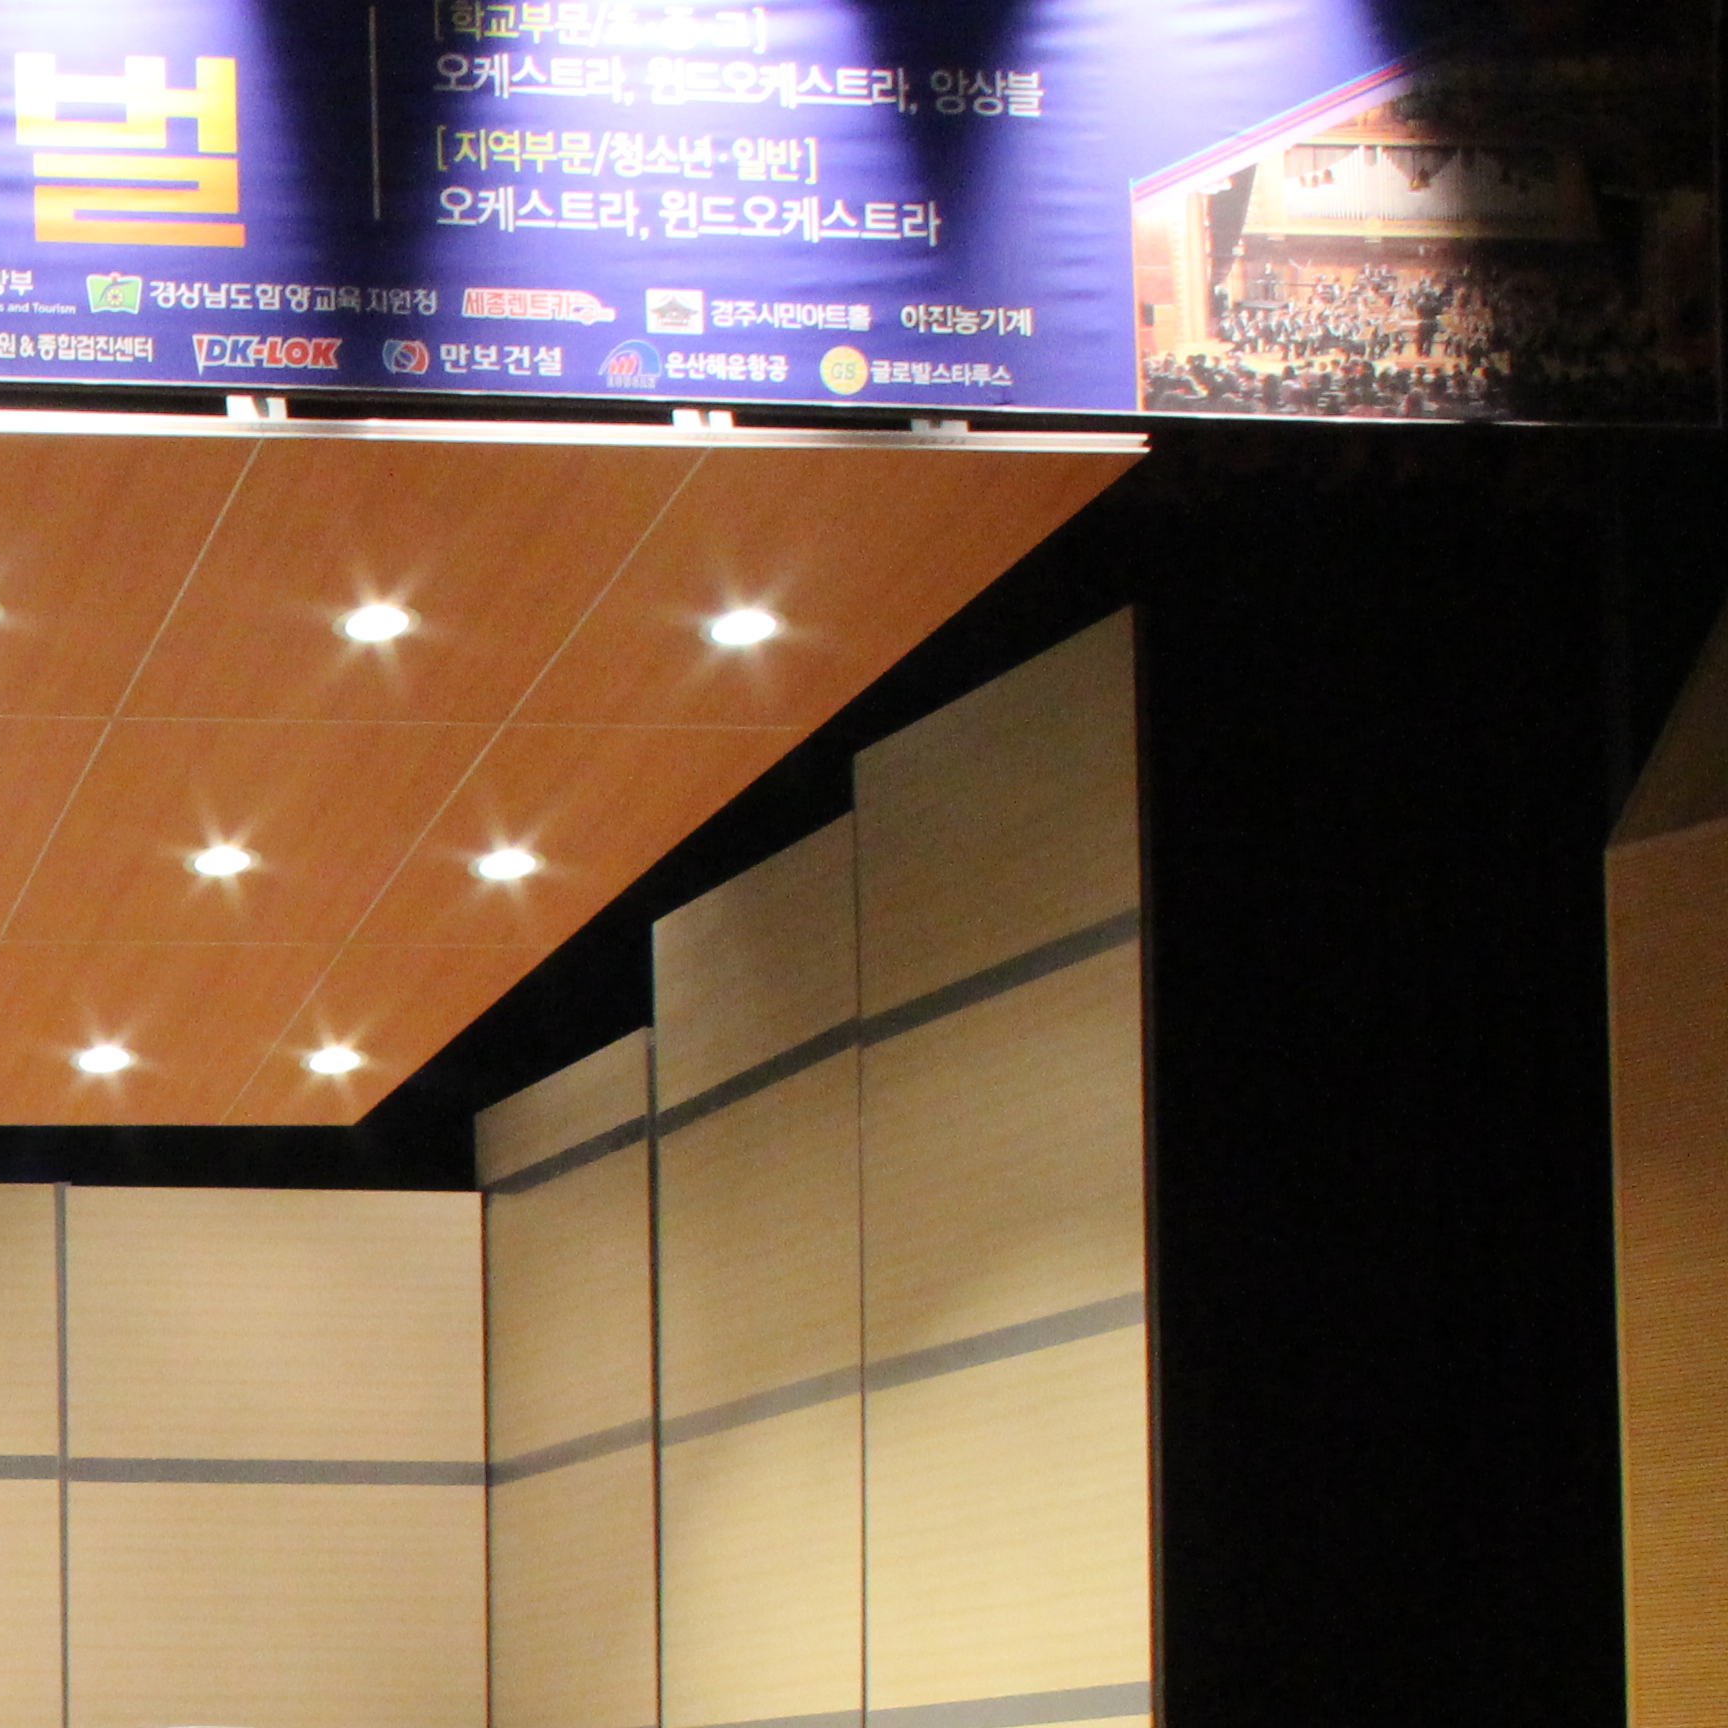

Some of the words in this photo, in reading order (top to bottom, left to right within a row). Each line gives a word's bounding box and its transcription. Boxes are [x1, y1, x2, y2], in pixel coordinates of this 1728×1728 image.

[433, 53, 634, 106] 오케스트라,
[930, 69, 1044, 117] 앙상블
[437, 186, 649, 241] 오케스트라,
[658, 191, 943, 246] 윈드오케스트라
[6, 301, 29, 313] and
[32, 301, 77, 315] Tourism
[710, 299, 871, 331] 경주시민아트홀
[900, 304, 1034, 336] 아진농기계
[20, 336, 35, 358] &
[37, 333, 155, 362] 종합검진센터
[192, 333, 342, 373] DK-LOK
[439, 343, 563, 376] 만보건설
[664, 350, 790, 382] 은산해운항공
